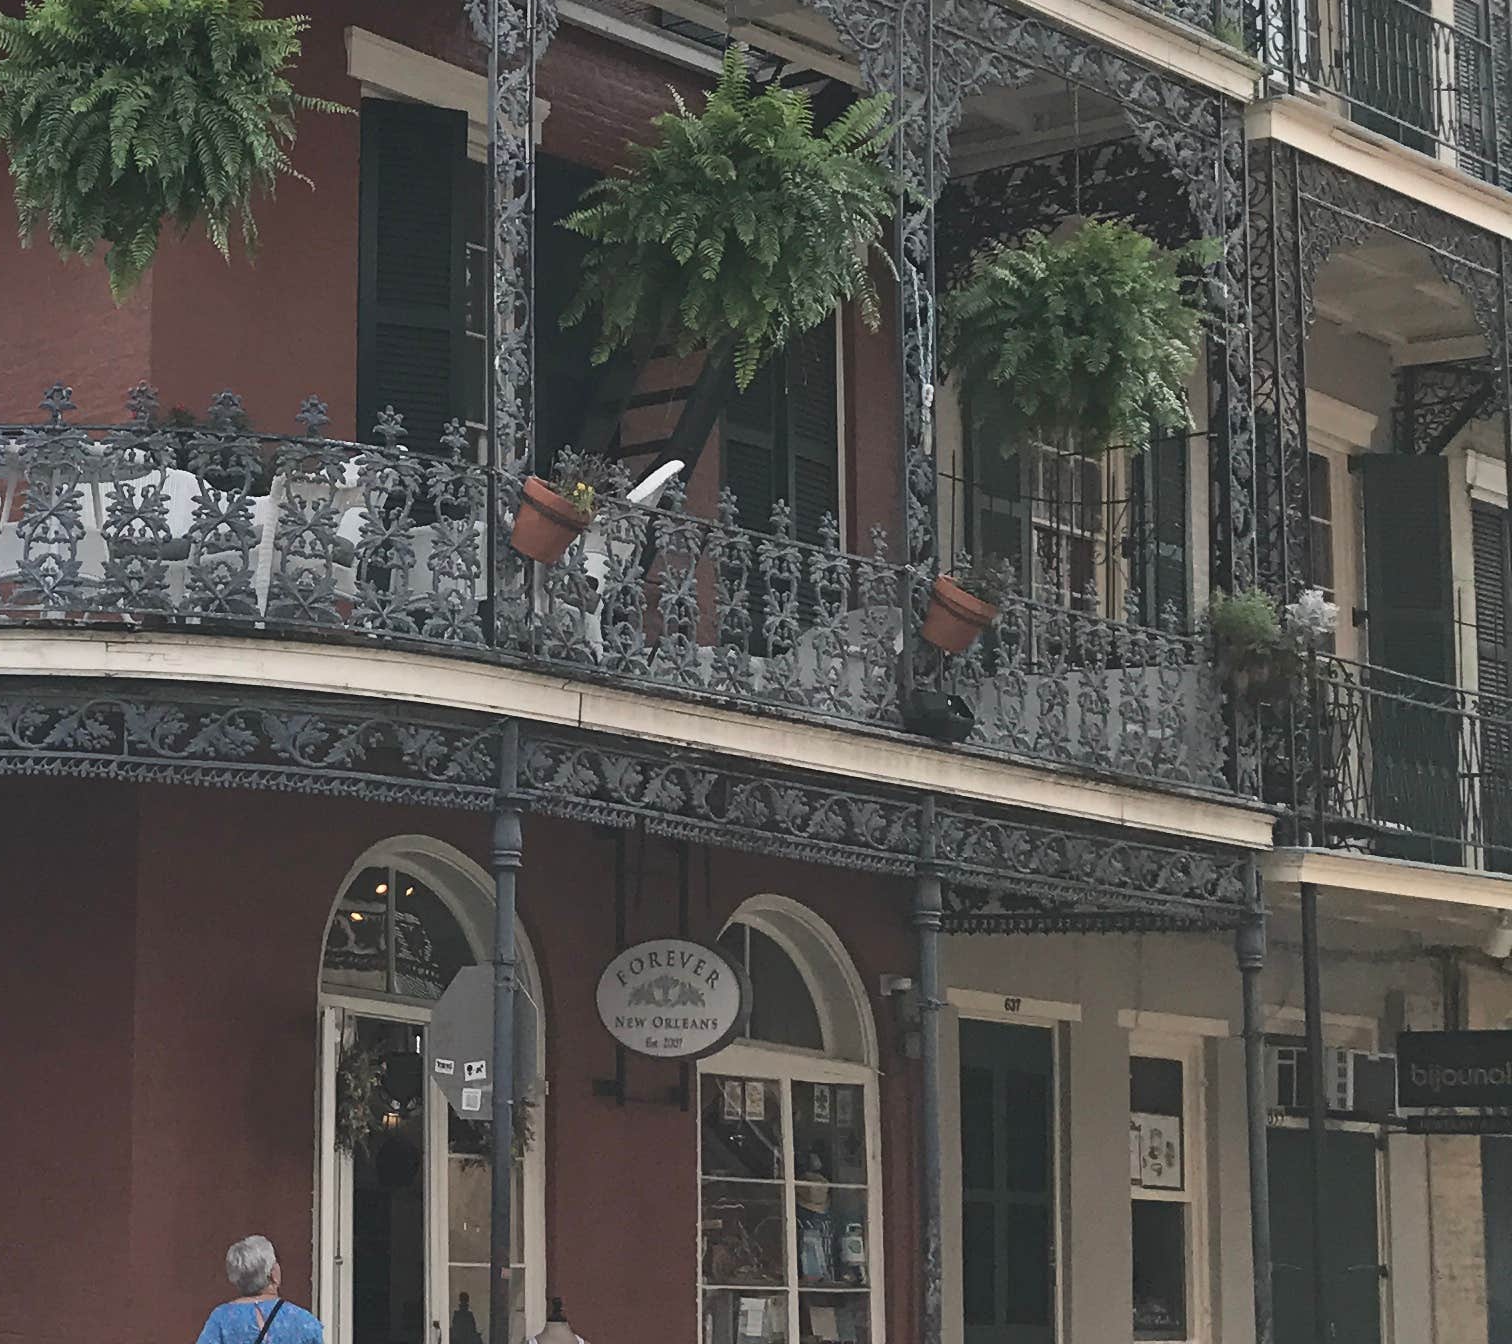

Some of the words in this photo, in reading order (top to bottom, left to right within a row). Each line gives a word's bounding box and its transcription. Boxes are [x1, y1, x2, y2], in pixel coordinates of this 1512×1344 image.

[616, 950, 720, 989] FOREVER
[615, 1016, 647, 1028] NEW
[652, 1016, 719, 1030] ORLEANS
